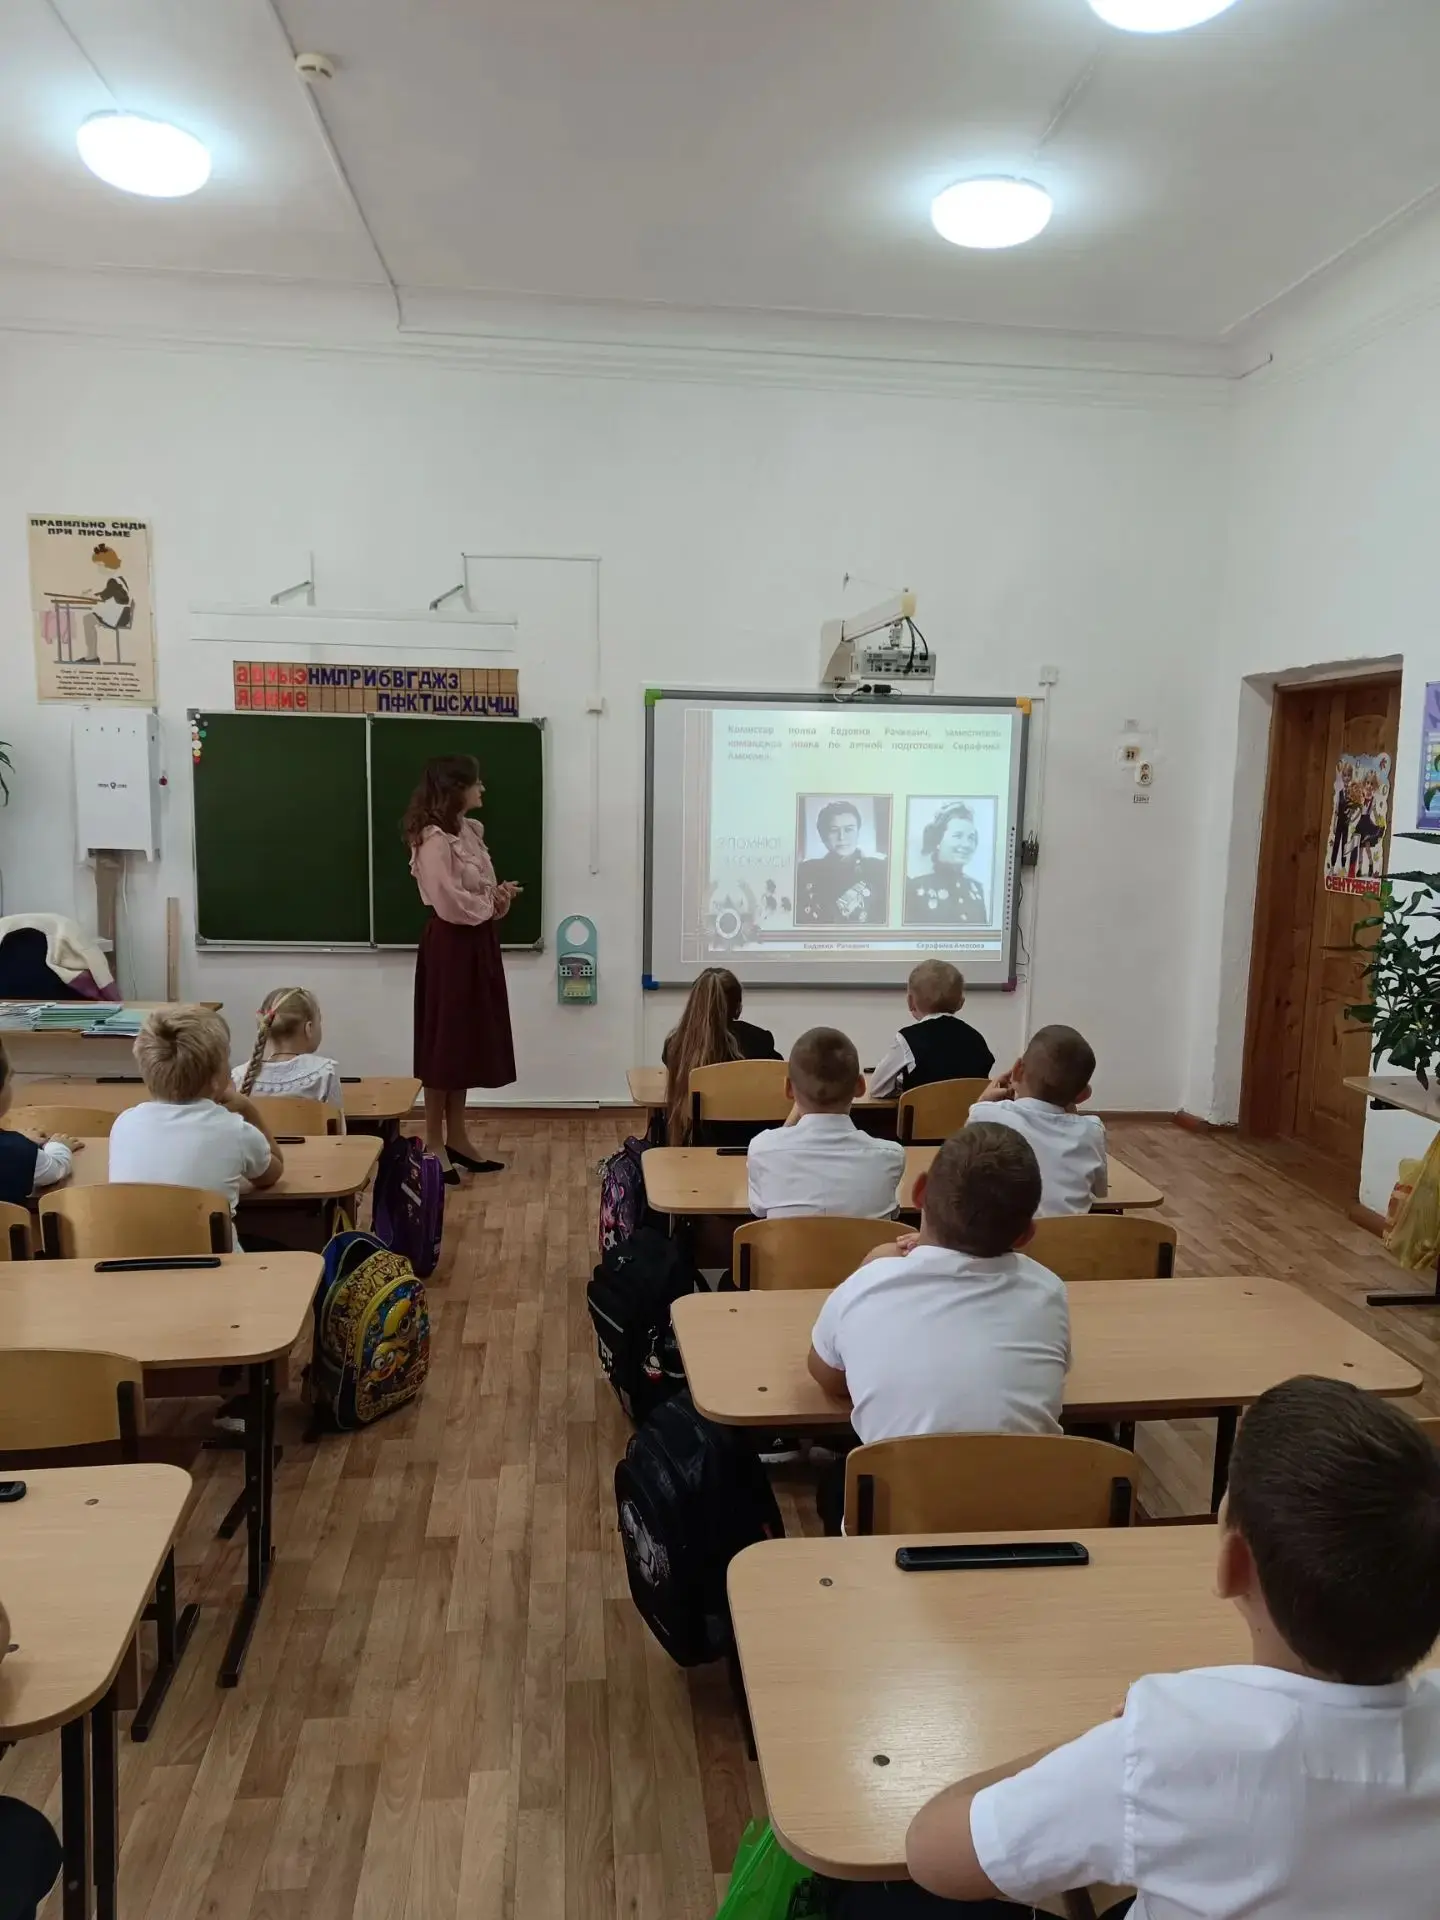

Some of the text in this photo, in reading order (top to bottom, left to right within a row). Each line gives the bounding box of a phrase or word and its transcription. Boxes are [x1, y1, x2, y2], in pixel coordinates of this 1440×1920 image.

[31, 519, 147, 530] ПРАВИЛЬНО СИДИ
[47, 528, 131, 538] ПРИ ПИСЬМЕ
